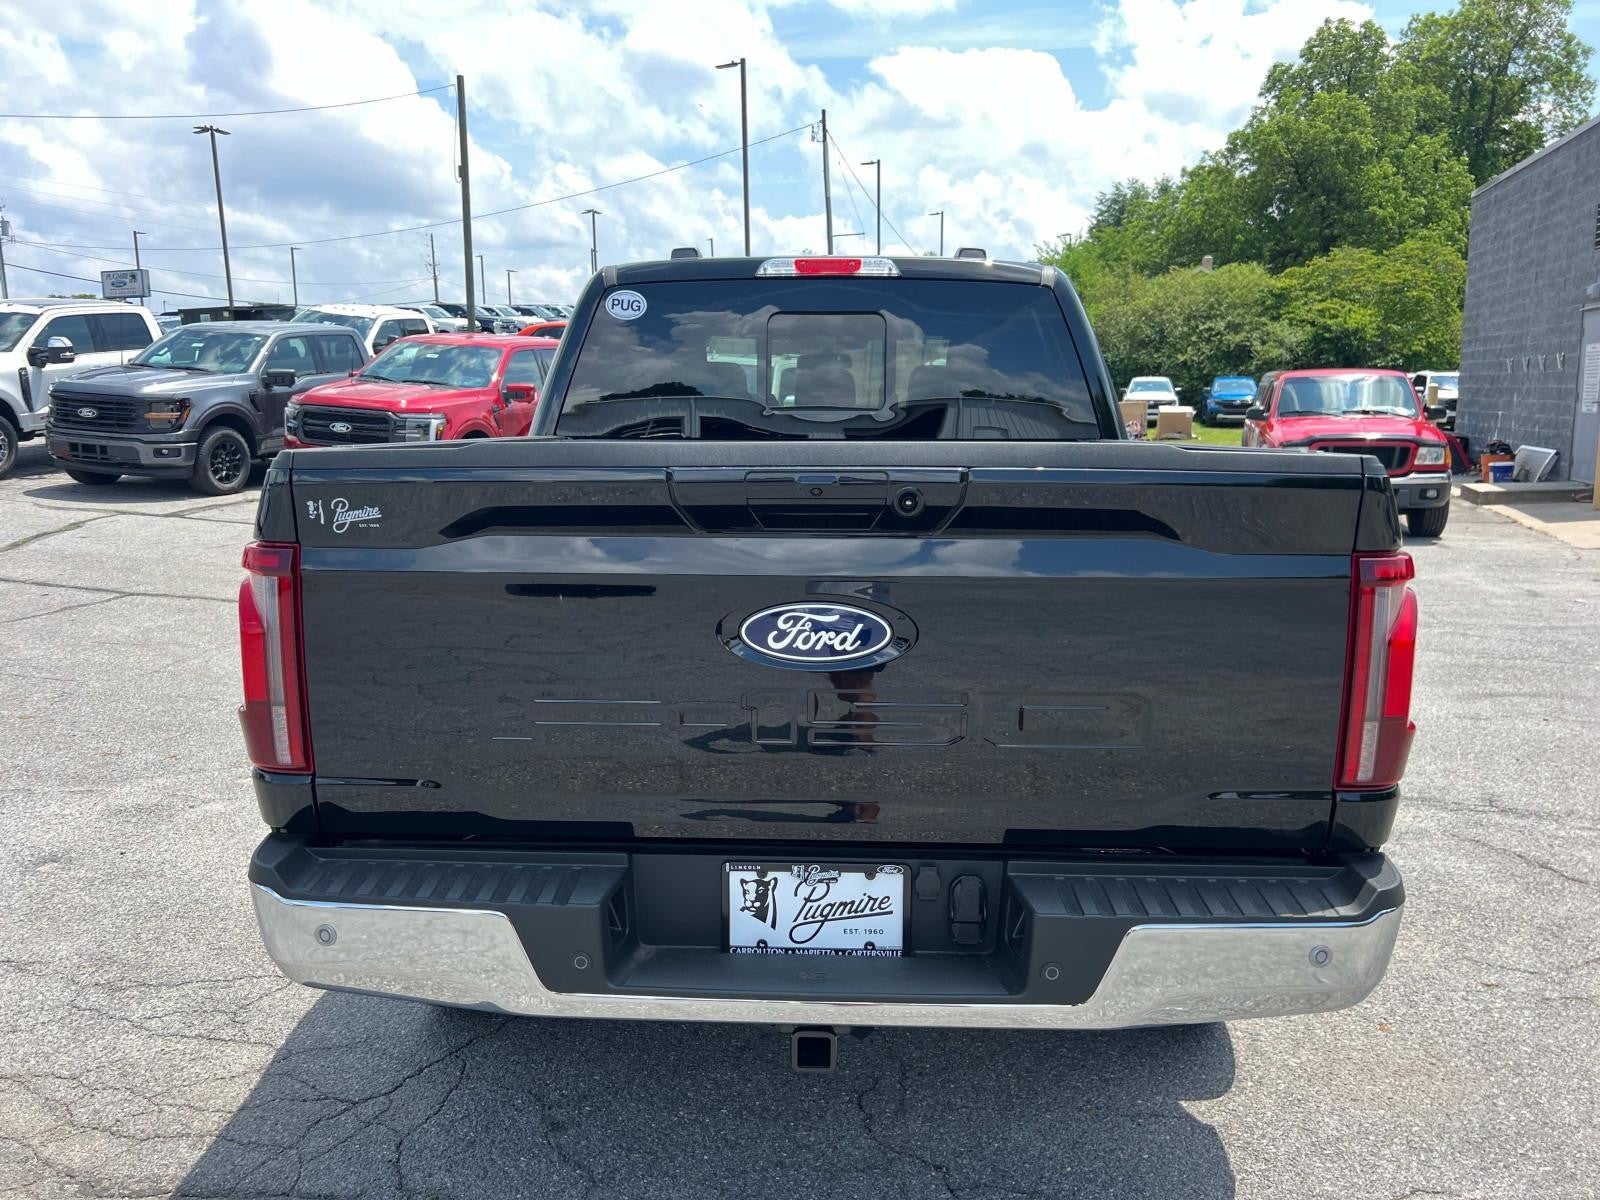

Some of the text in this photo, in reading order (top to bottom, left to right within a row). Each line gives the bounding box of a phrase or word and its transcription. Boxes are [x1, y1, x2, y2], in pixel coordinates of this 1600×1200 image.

[611, 298, 641, 312] PUG
[331, 498, 382, 533] Pugmire
[767, 612, 864, 652] Ford
[789, 881, 894, 944] Pugmire
[845, 950, 903, 958] CARTERSVILLE
